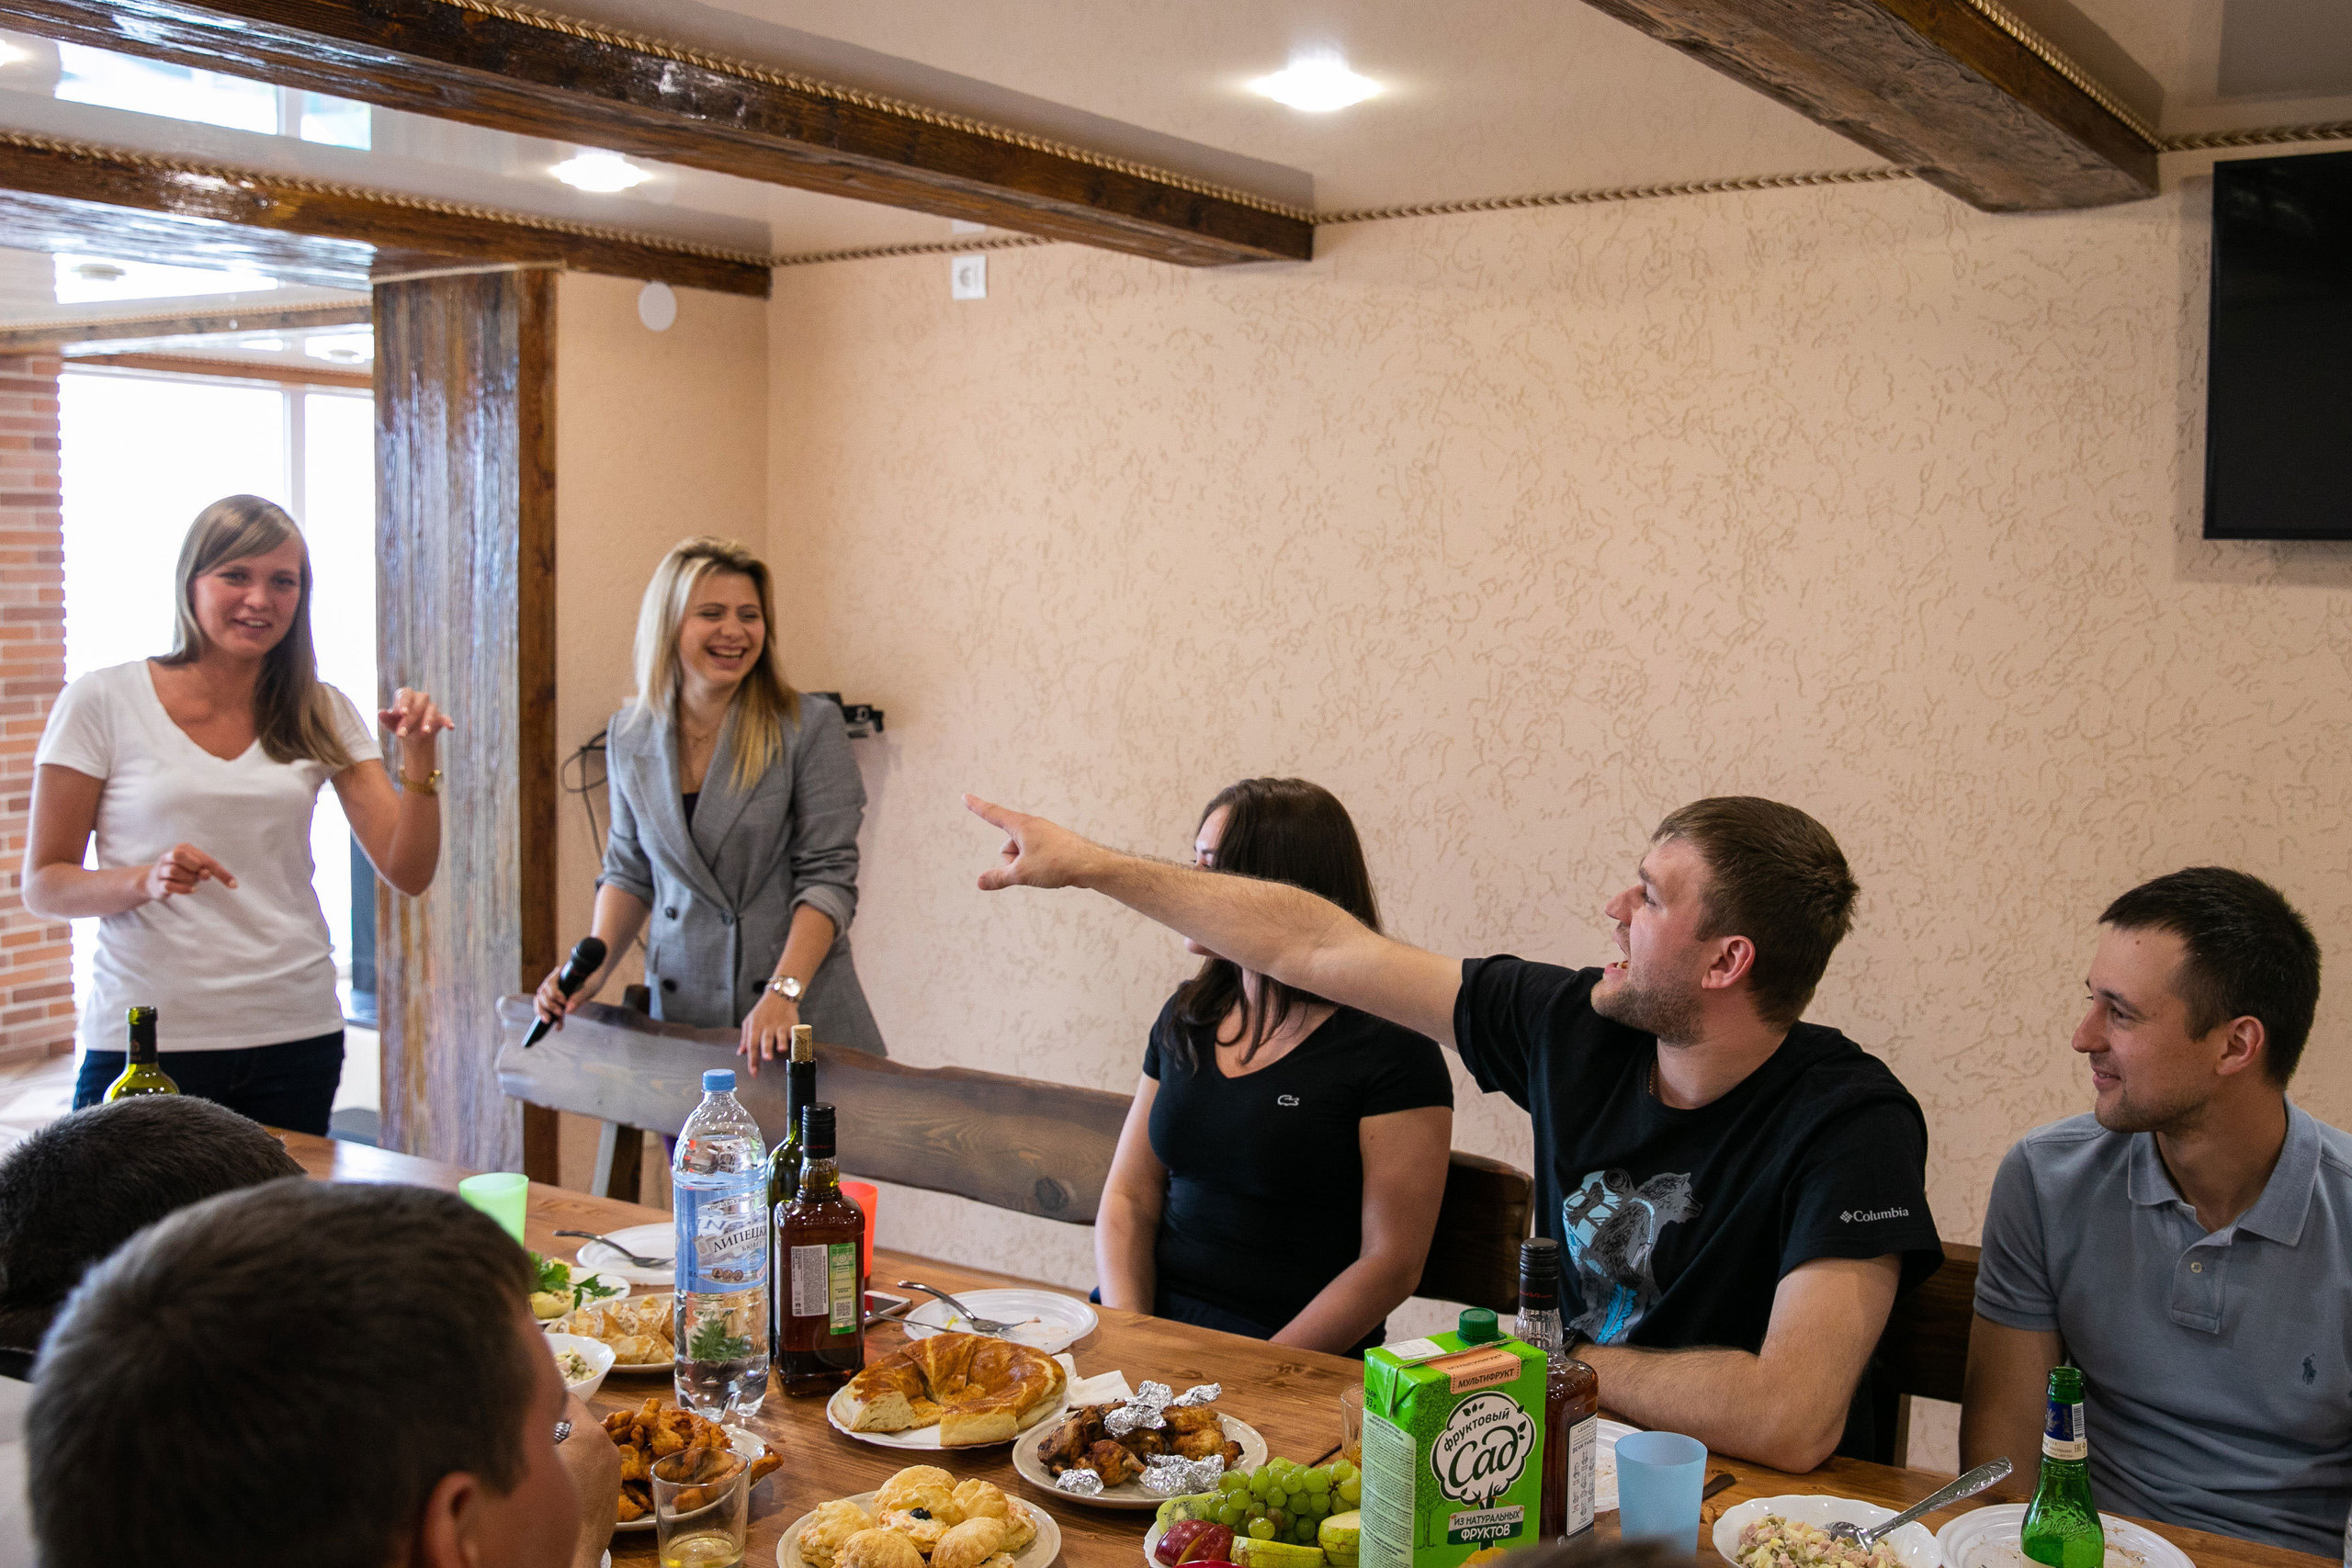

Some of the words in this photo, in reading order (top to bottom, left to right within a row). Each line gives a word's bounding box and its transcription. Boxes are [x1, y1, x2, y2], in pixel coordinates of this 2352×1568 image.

[1853, 1206, 1909, 1223] Columbia
[714, 1225, 768, 1254] ЛИПЕЦК
[1457, 1369, 1515, 1389] МУЛЬТИФРУКТ
[1448, 1425, 1519, 1489] Сад
[1453, 1517, 1464, 1527] ИЗ
[1465, 1510, 1521, 1526] НАТУРАЛЬНЫХ
[1460, 1523, 1511, 1541] ФРУКТОВ
